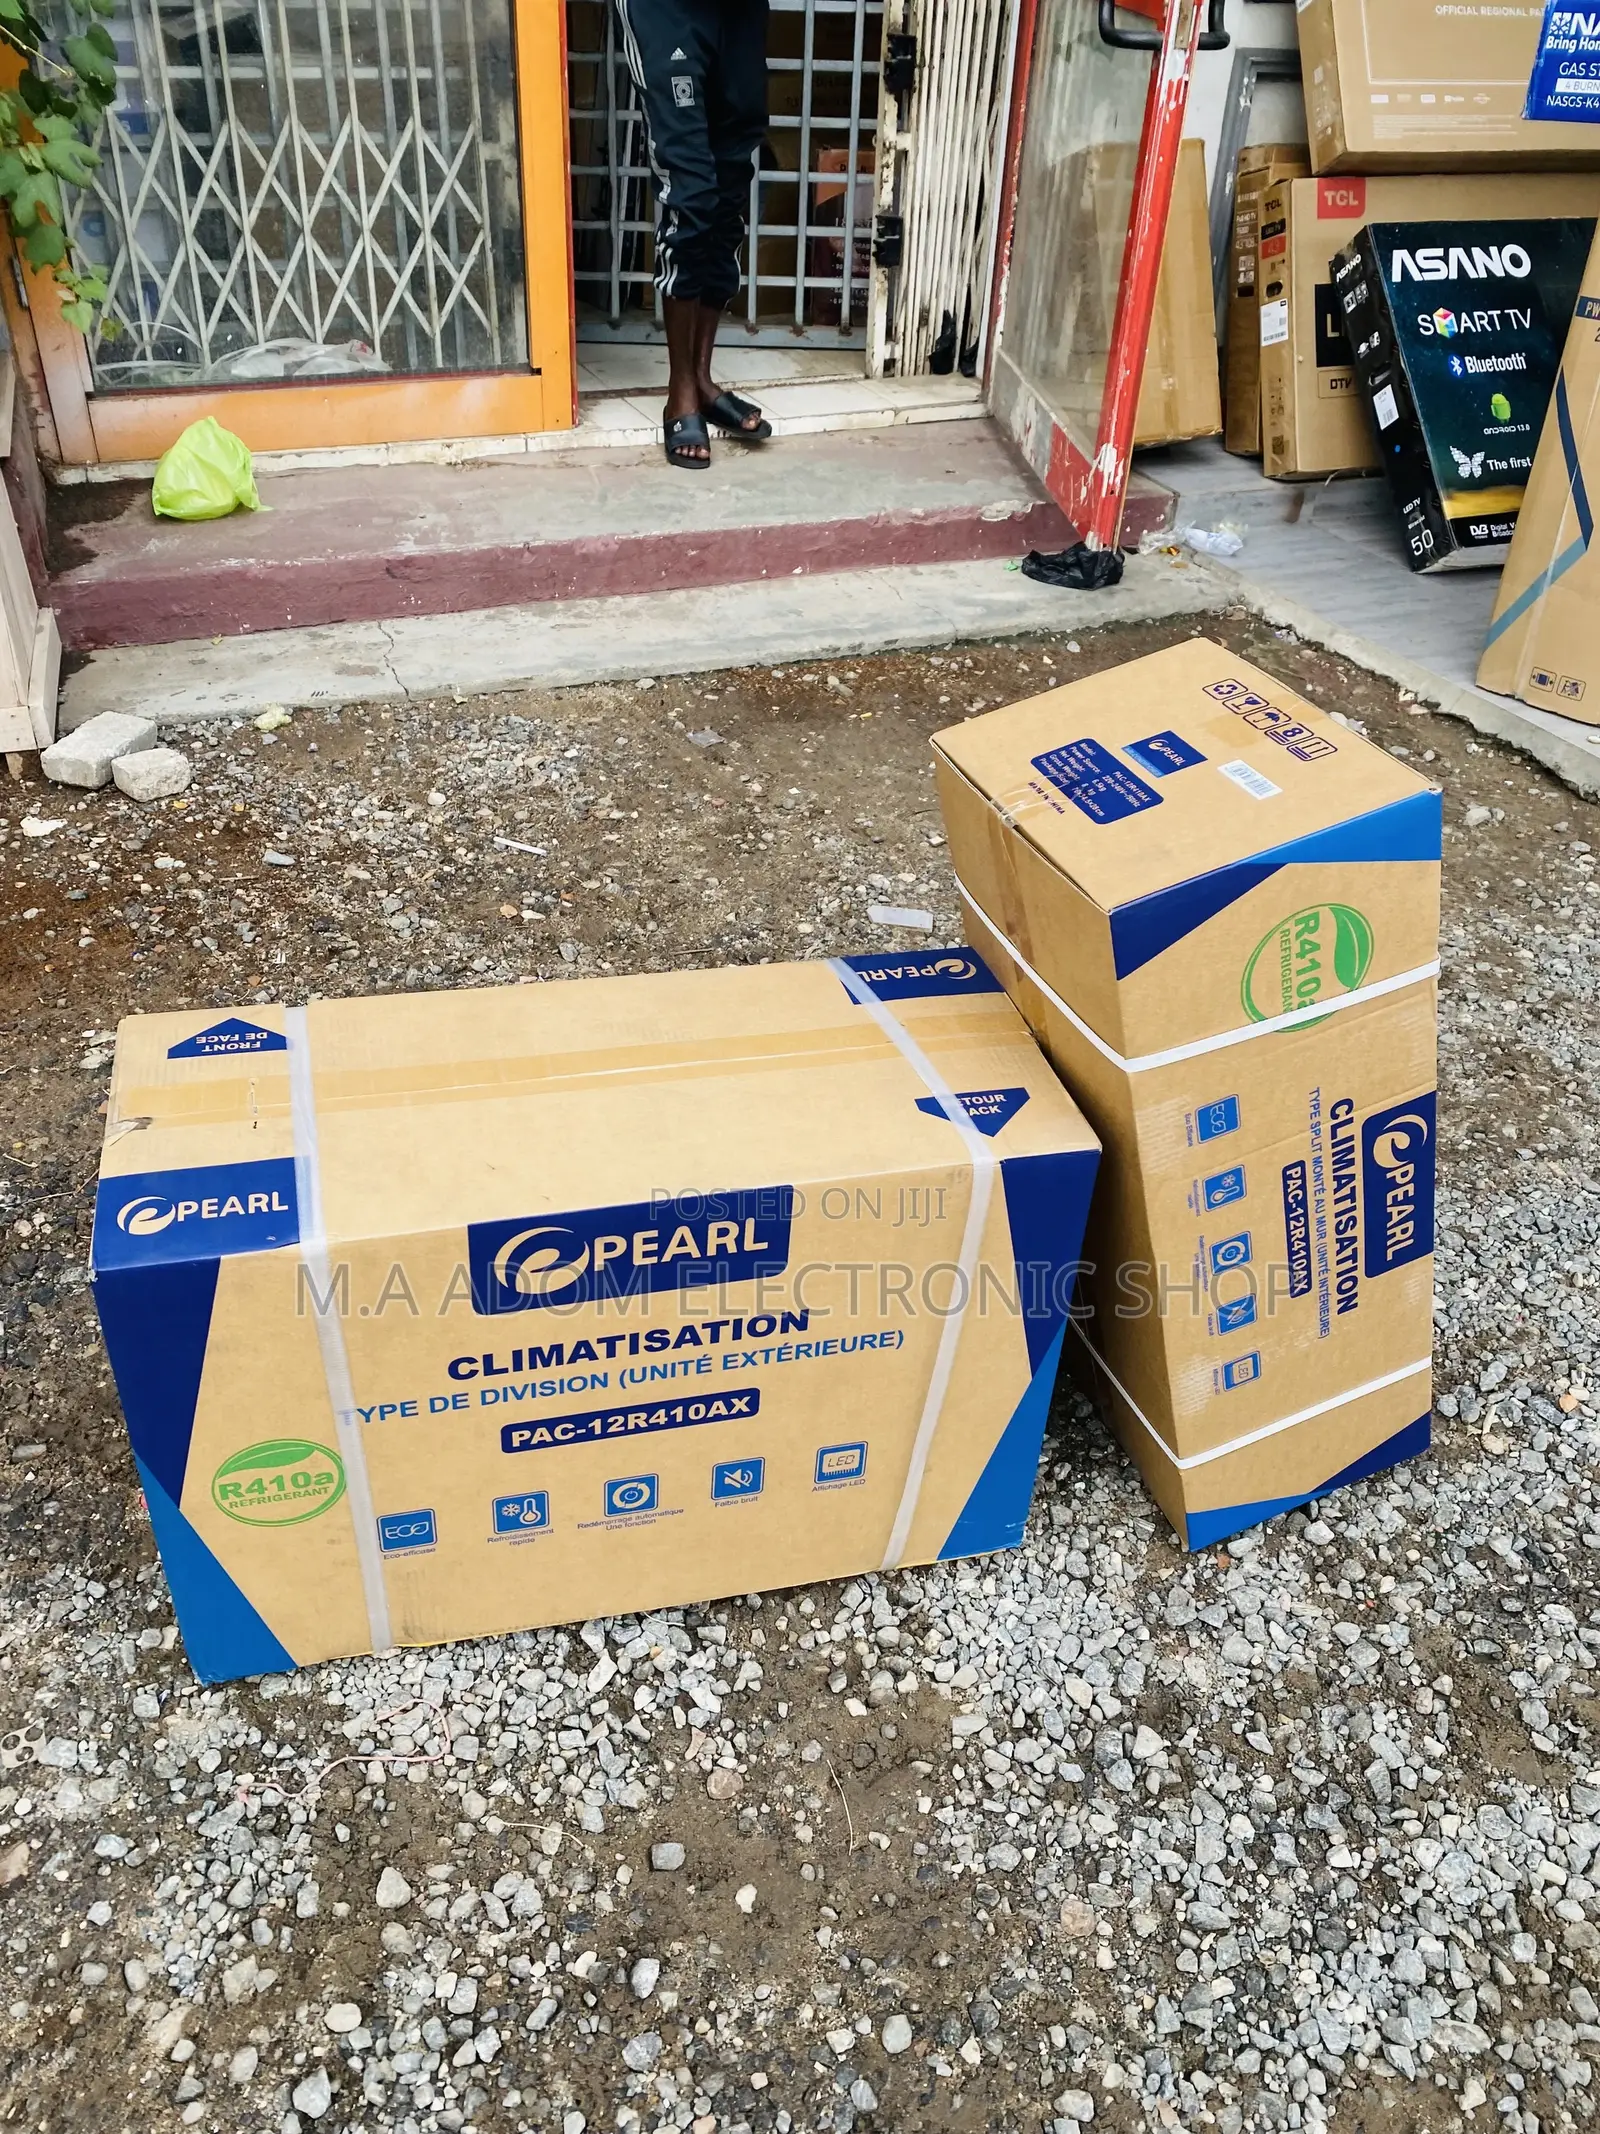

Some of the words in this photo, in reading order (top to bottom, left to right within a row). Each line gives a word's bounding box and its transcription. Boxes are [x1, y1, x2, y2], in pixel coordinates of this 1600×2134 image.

[1435, 5, 1478, 16] OFFICIAL
[1481, 6, 1527, 17] REGIONAL
[1546, 36, 1577, 53] Bring
[1559, 61, 1586, 76] GAS
[1265, 199, 1282, 211] TCL
[1324, 190, 1359, 206] TCL
[1336, 254, 1361, 283] ASANO
[1392, 244, 1531, 283] ASANO
[1504, 308, 1531, 330] TV
[1464, 353, 1527, 374] Bluetooth
[1487, 459, 1508, 471] The
[1509, 456, 1532, 469] first
[1403, 502, 1414, 514] LED
[1413, 497, 1421, 506] TV
[1411, 529, 1434, 556] 50
[1160, 746, 1187, 766] PEARL
[1028, 781, 1044, 795] MADE
[196, 1034, 239, 1044] FACE
[245, 1032, 268, 1040] DE
[201, 1041, 261, 1053] FRONT
[967, 1105, 1002, 1117] ACK
[1308, 1087, 1321, 1118] TYPE
[1310, 1121, 1322, 1153] SPLIT
[1311, 1155, 1327, 1196] MONTÉ
[177, 1191, 288, 1222] PEARL
[1315, 1197, 1326, 1214] AU
[1329, 1098, 1358, 1315] CLIMATISATION
[1386, 1162, 1416, 1262] PEARL
[1286, 1165, 1309, 1295] PAC-12R410AX
[1315, 1215, 1327, 1240] MUR
[593, 1217, 769, 1272] PEARL
[1315, 1242, 1328, 1277] (UNITÉ
[447, 1309, 810, 1381] CLIMATISATION
[429, 1393, 470, 1413] DE
[480, 1372, 609, 1406] DIVISION
[619, 1354, 713, 1389] (UNITÉ
[722, 1330, 904, 1371] EXTÉRIEURE)
[511, 1395, 751, 1448] PAC-12R410AX
[827, 1454, 855, 1468] LED
[218, 1471, 335, 1501] R410a
[812, 1482, 847, 1492] Affichage
[849, 1478, 866, 1488] LED
[229, 1486, 330, 1509] REFRIGERANT
[714, 1499, 739, 1508] Faible
[577, 1515, 633, 1530] Redémarrage
[635, 1508, 684, 1521] automatique
[606, 1523, 623, 1531] Une
[624, 1518, 656, 1529] fonction
[487, 1529, 554, 1544] Refroidissement
